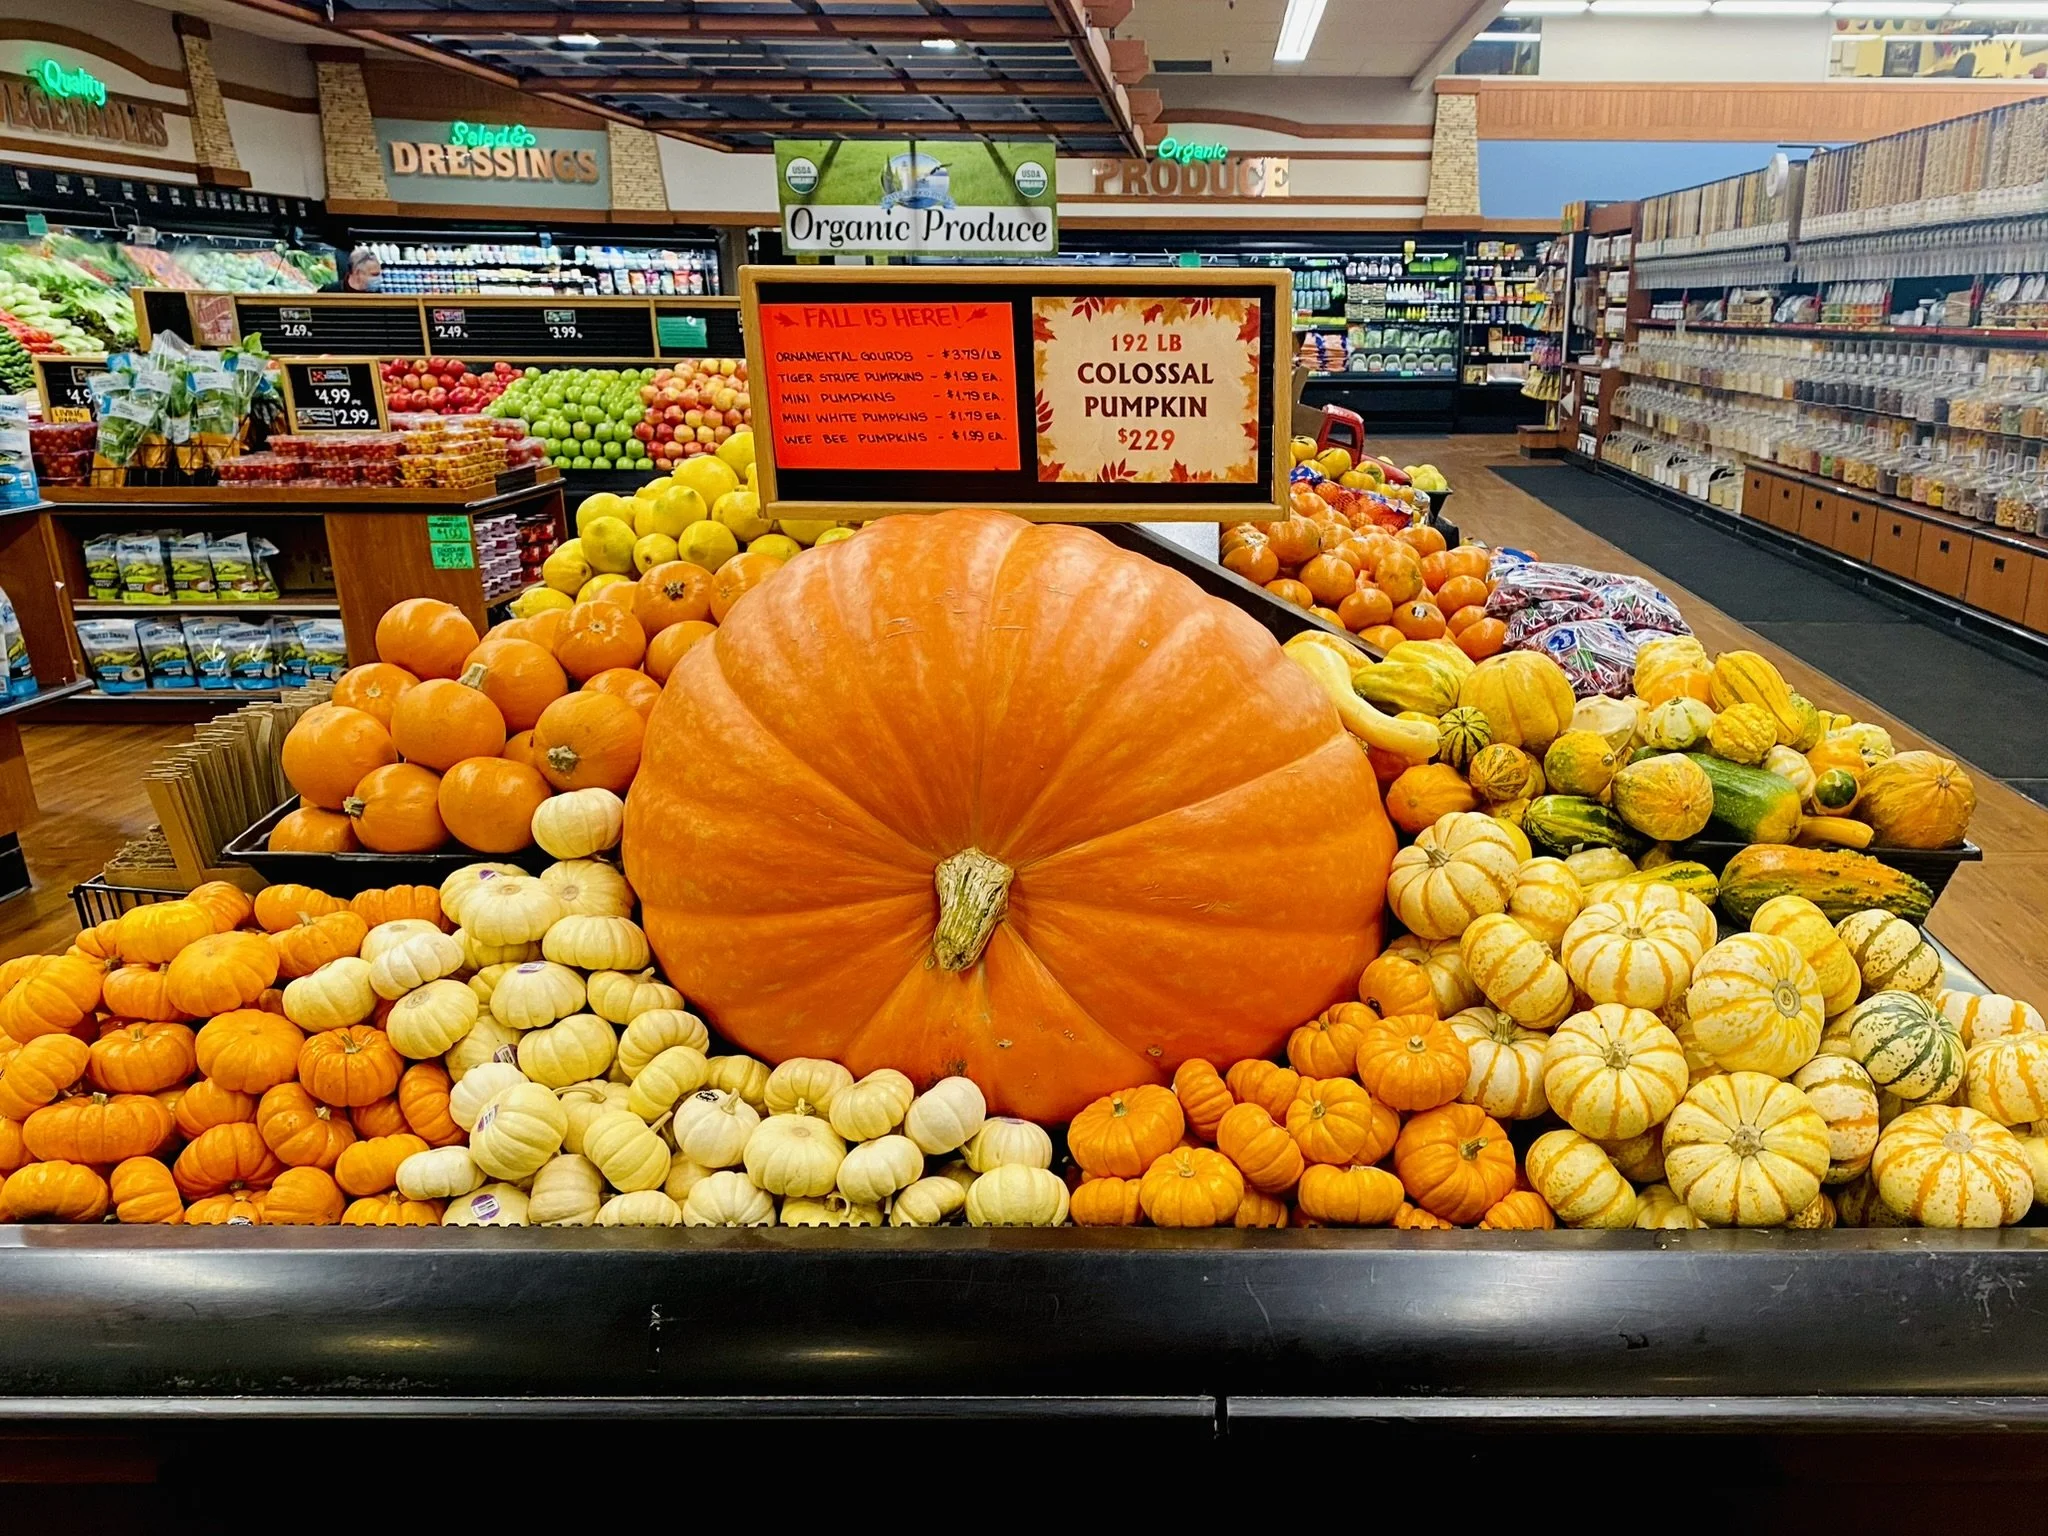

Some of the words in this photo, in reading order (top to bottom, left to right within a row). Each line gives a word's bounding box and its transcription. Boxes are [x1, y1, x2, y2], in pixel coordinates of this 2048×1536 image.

[43, 59, 106, 106] Quality
[0, 82, 169, 147] EGETABLES
[1158, 137, 1228, 164] Organic
[389, 141, 600, 184] DRESSINGS
[792, 166, 812, 174] USDA
[1021, 170, 1041, 178] USDA
[1092, 157, 1290, 197] PRODUCE
[790, 207, 910, 248] Organic
[922, 208, 1047, 242] Produce
[803, 307, 861, 328] FALL
[863, 308, 888, 327] IS
[891, 305, 962, 328] HERE!
[1111, 333, 1148, 351] 192
[1157, 333, 1182, 351] LB
[776, 351, 858, 362] ORNAMENTAL
[860, 351, 913, 362] GOURDS
[942, 348, 1002, 360] $3.79/LB
[777, 373, 815, 383] TIGER
[819, 372, 860, 383] STRIPE
[864, 371, 924, 383] PUMPKINS
[944, 370, 978, 382] $1.99
[1077, 362, 1214, 384] COLOSSAL
[314, 388, 351, 405] $4.99
[781, 393, 811, 404] MINI
[820, 392, 896, 403] PUMPKINS
[335, 408, 369, 424] $2.99
[782, 413, 811, 423] MINI
[815, 412, 857, 423] WHITE
[861, 412, 928, 423] PUMPKINS
[949, 410, 983, 421] $1.79
[1085, 396, 1207, 418] PUMPKIN
[784, 434, 812, 444] WEE
[822, 434, 848, 444] BEE
[857, 433, 928, 443] PUMPKINS
[952, 430, 985, 442] $1.99
[1118, 428, 1175, 450] $229
